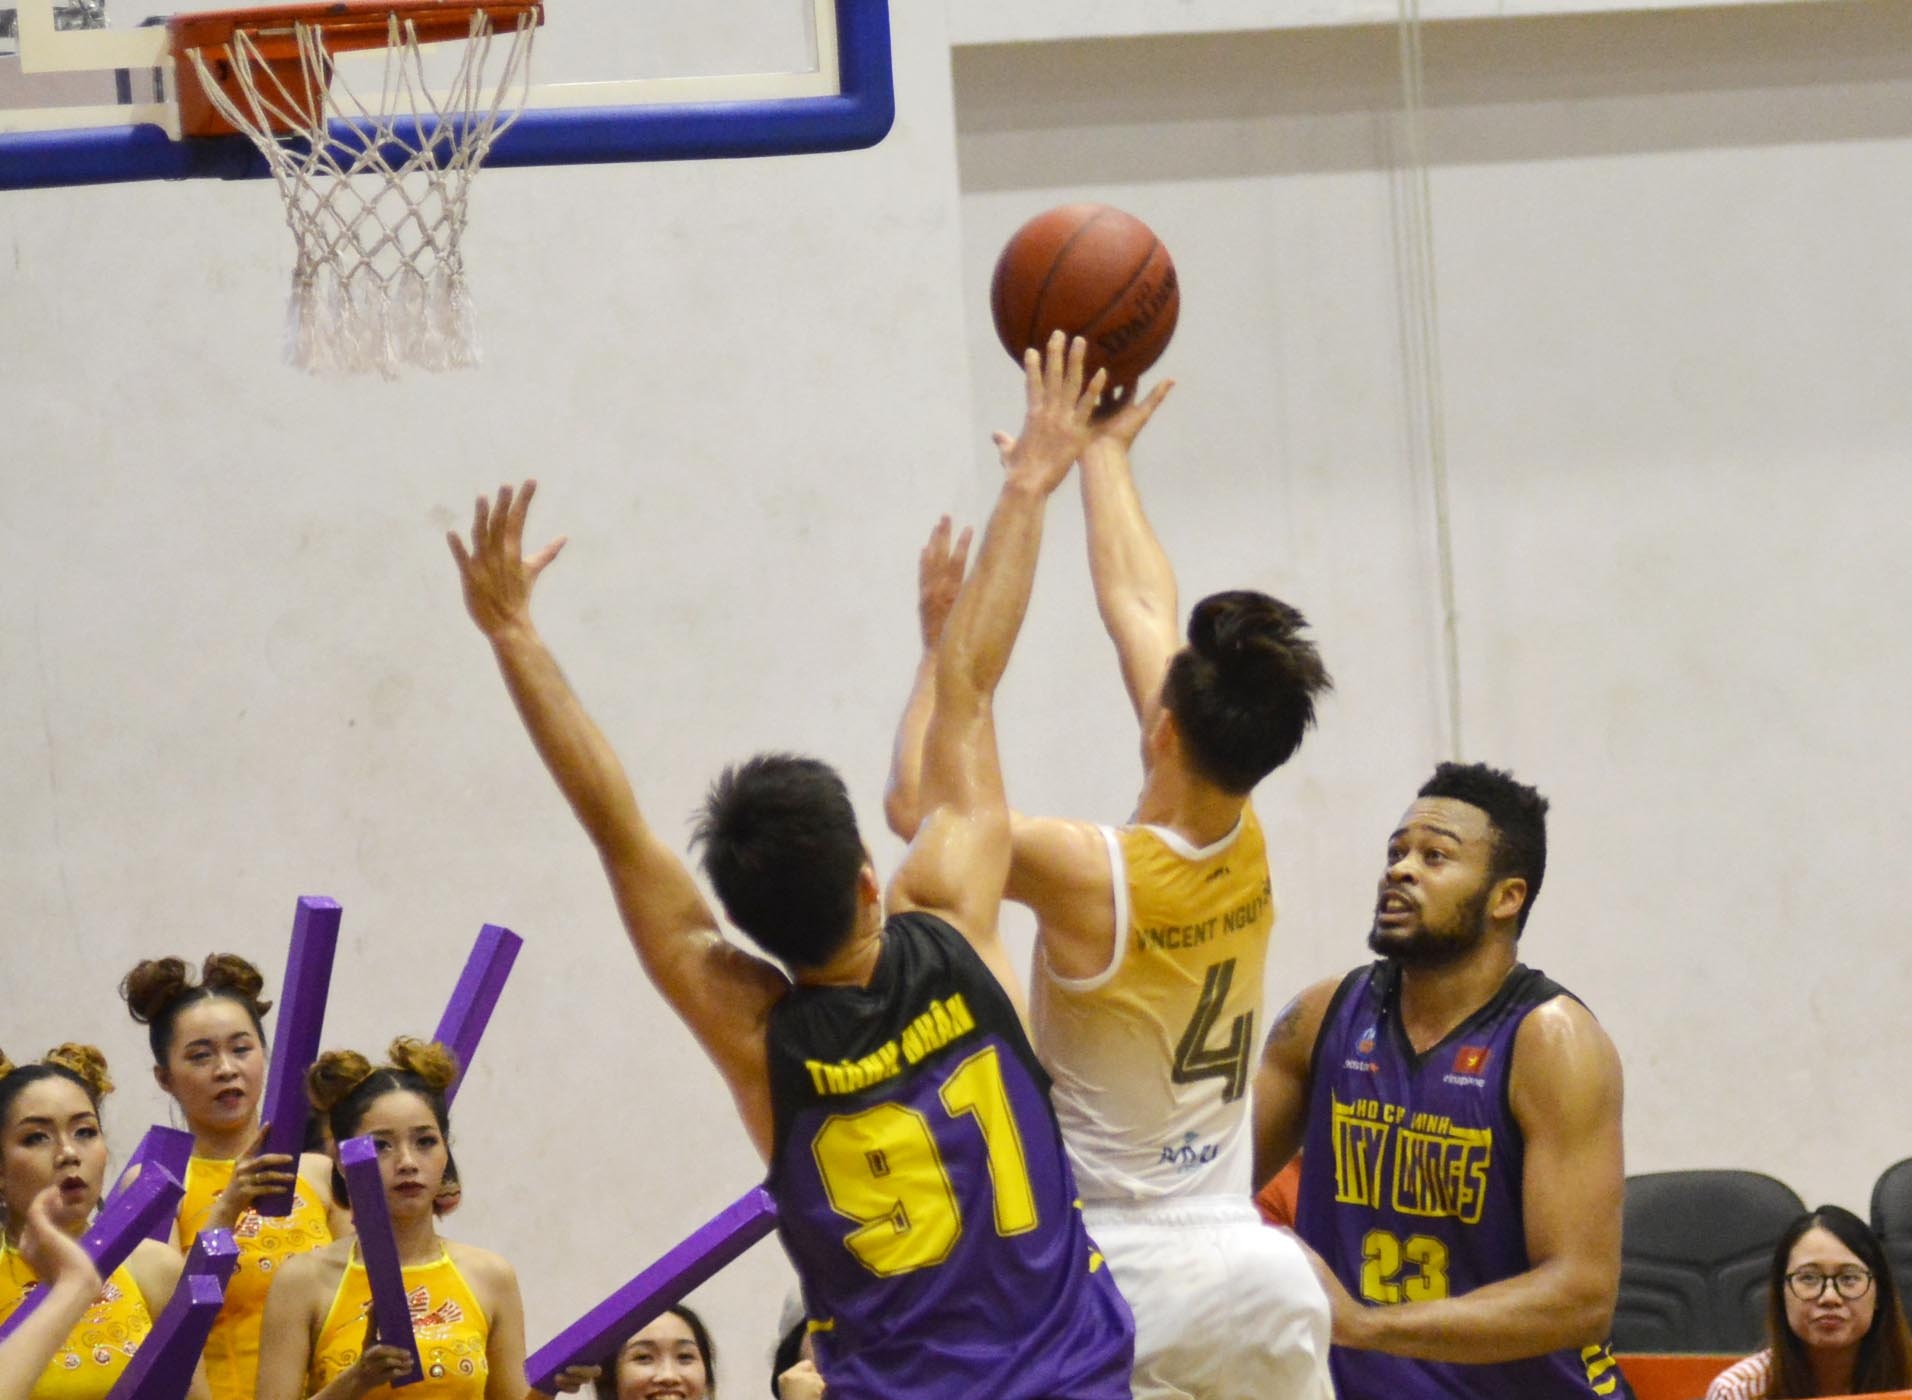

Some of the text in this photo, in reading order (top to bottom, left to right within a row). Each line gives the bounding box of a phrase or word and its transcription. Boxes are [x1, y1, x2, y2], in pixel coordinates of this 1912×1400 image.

[1171, 958, 1253, 1104] 4
[811, 1044, 1038, 1278] 91
[1360, 1230, 1448, 1304] 23
